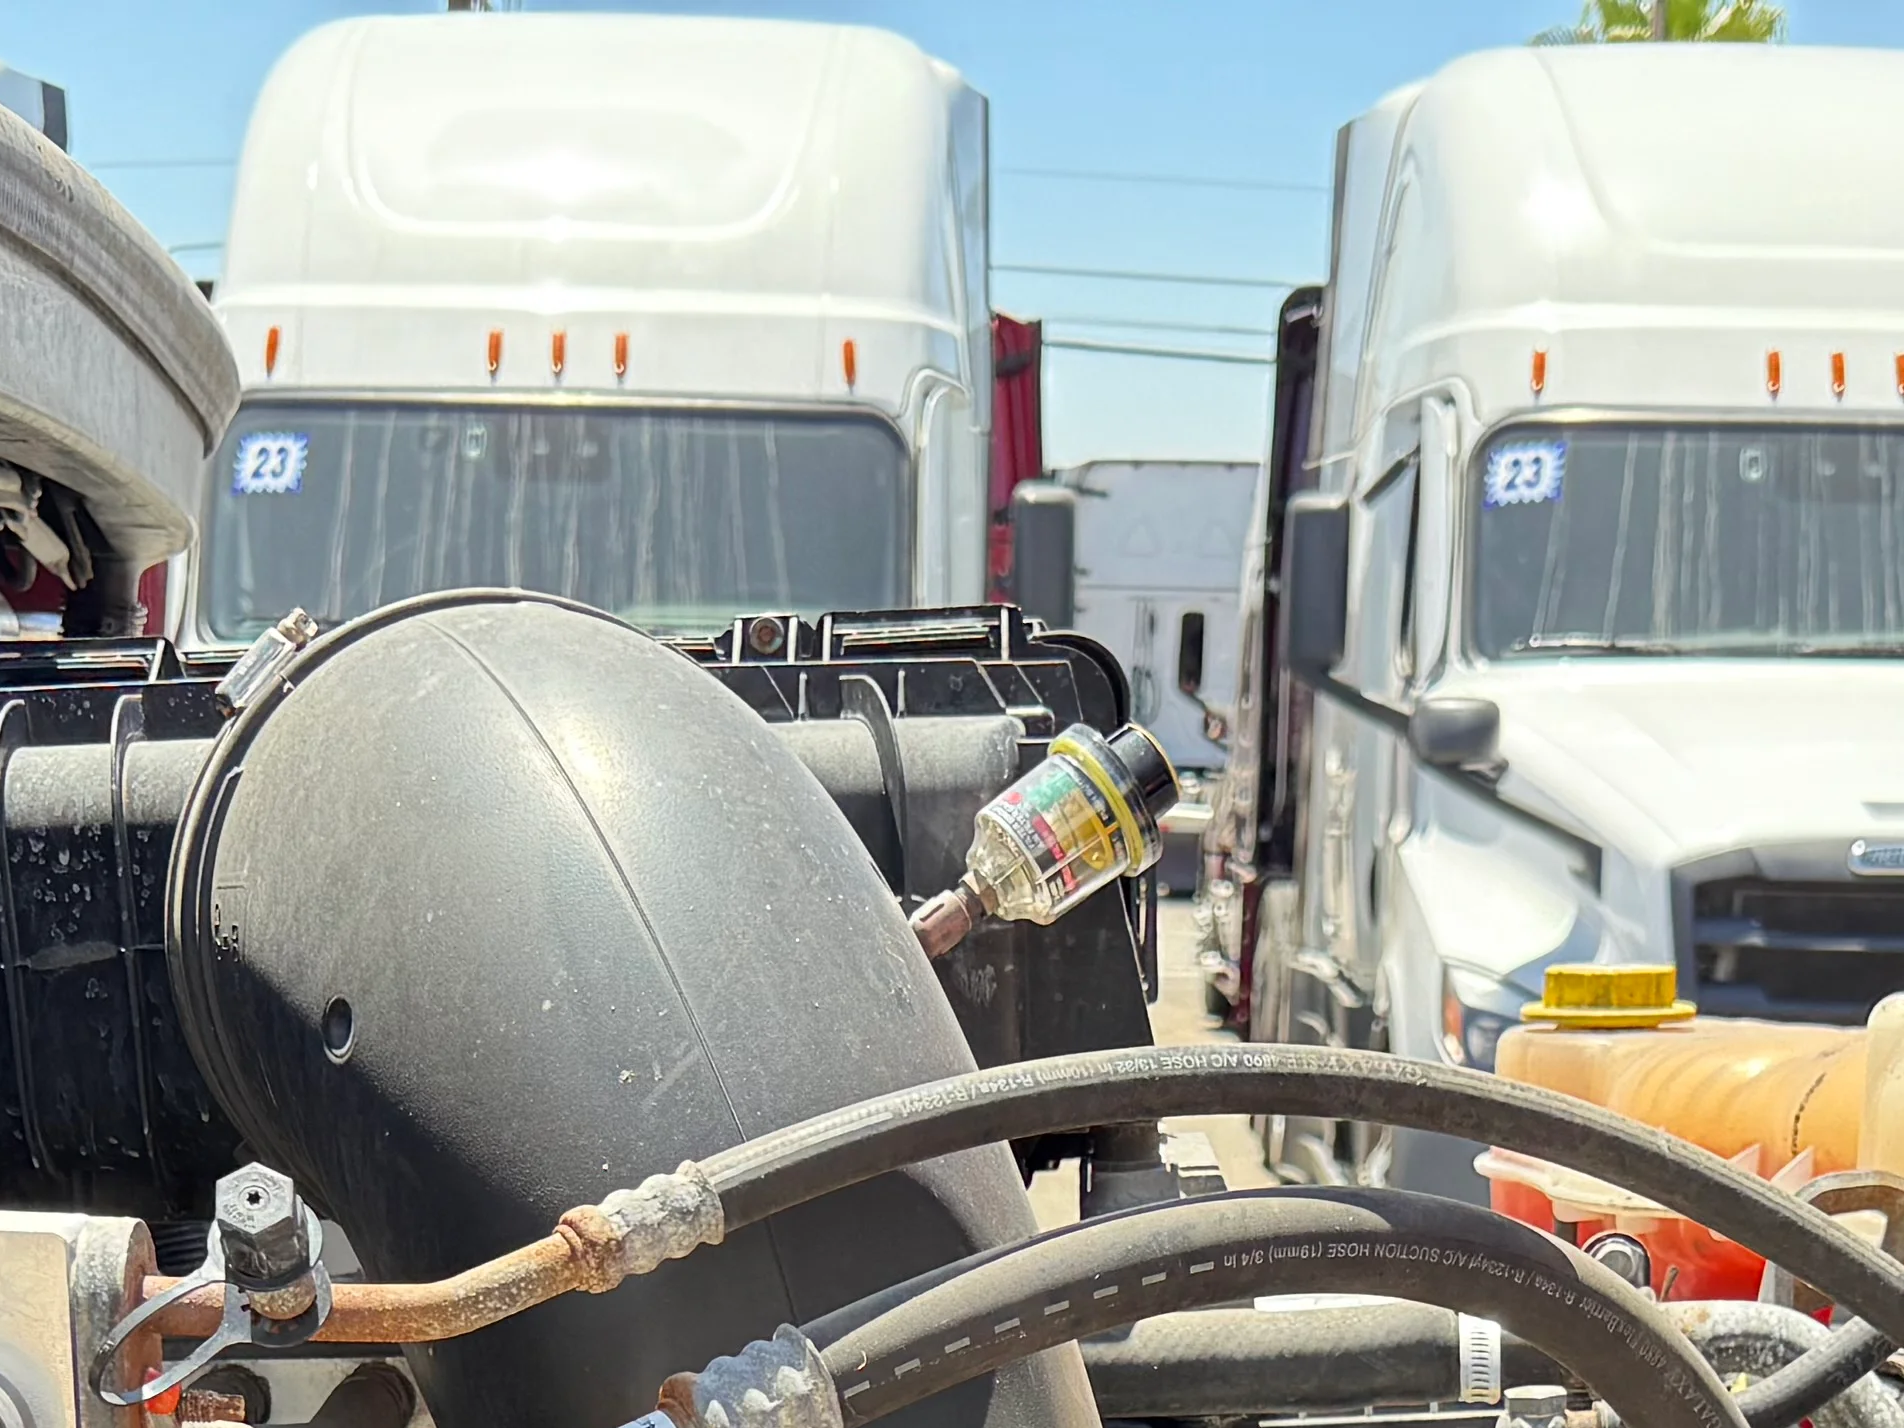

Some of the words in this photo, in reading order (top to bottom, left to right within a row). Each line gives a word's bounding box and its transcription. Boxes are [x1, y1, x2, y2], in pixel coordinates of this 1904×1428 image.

[248, 446, 291, 480] 23
[1500, 456, 1545, 495] 23
[1160, 1053, 1208, 1071] HOSE
[1210, 1053, 1239, 1070] A/C
[1241, 1249, 1265, 1267] 3/4
[1268, 1242, 1323, 1264] (19mm)
[1327, 1243, 1371, 1259] HOSE
[1373, 1243, 1440, 1263] SUCTION
[1442, 1250, 1465, 1268] A/C
